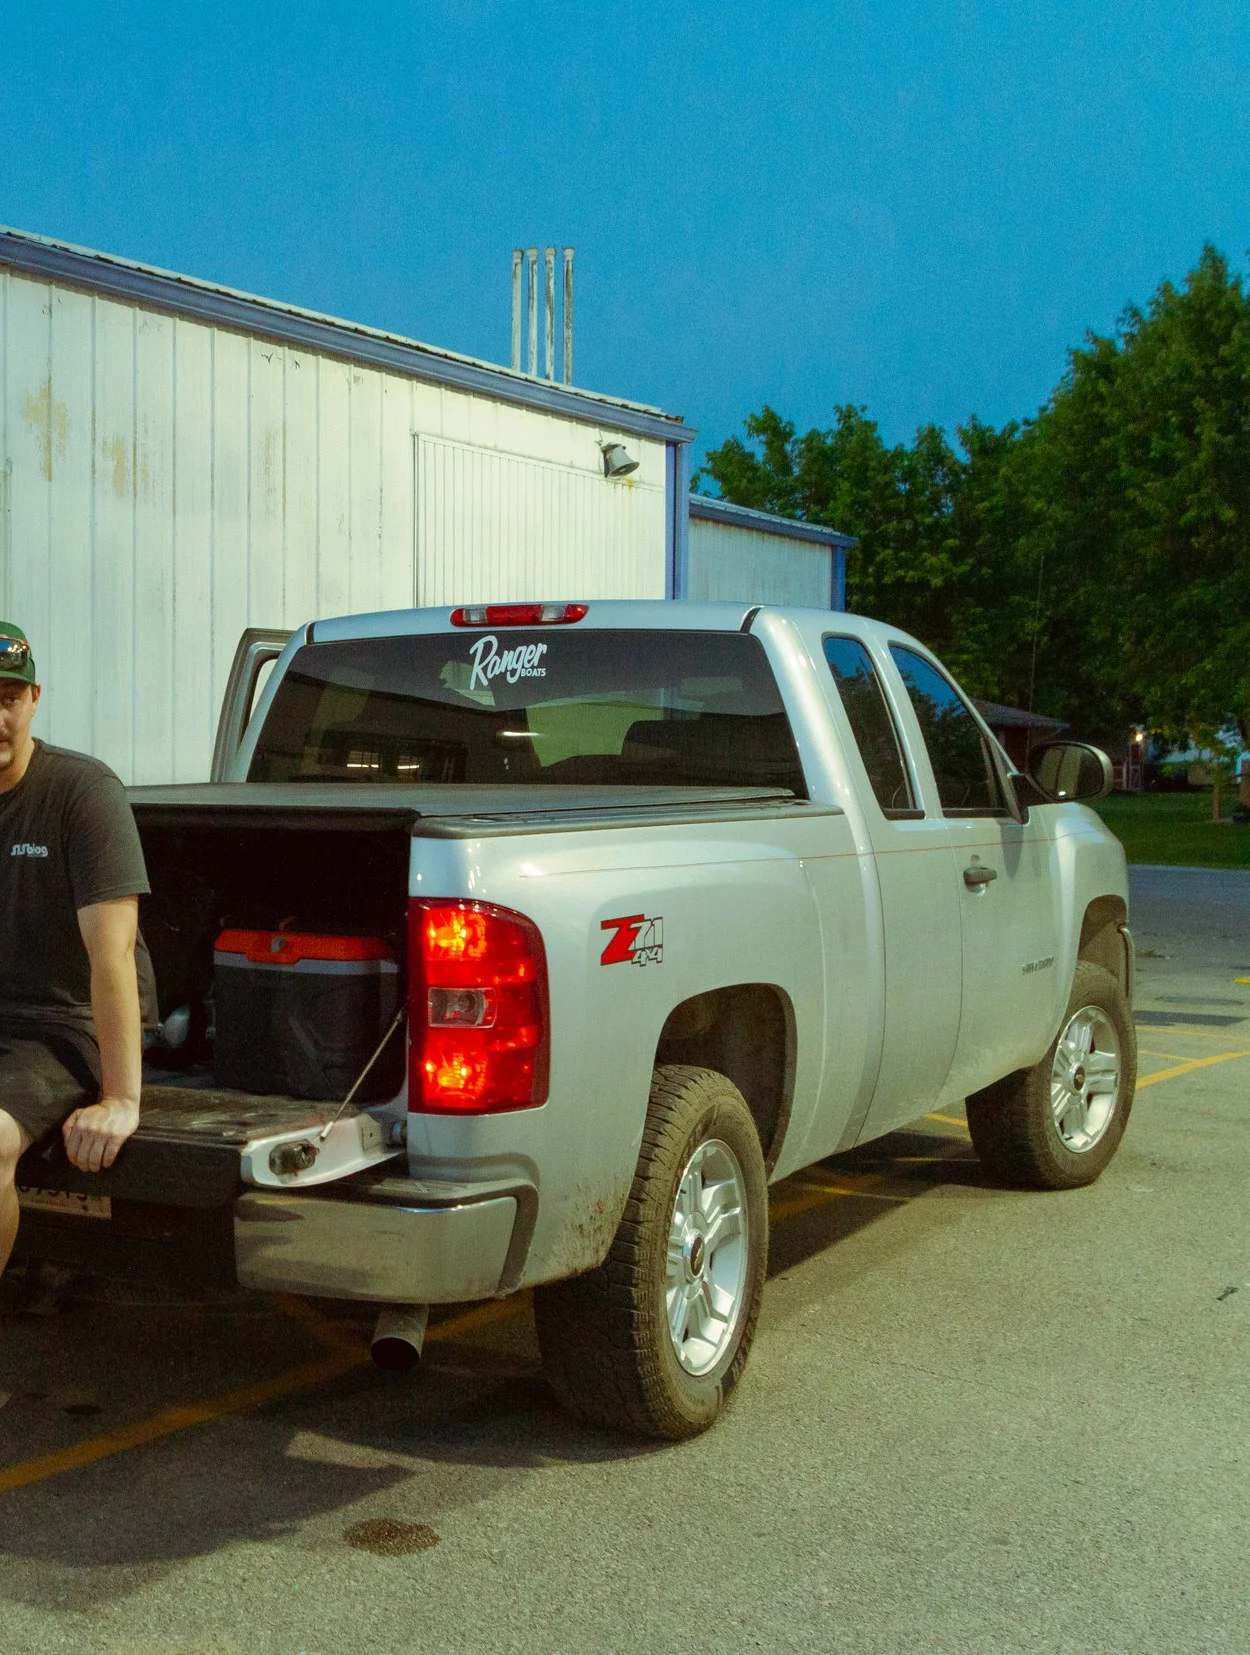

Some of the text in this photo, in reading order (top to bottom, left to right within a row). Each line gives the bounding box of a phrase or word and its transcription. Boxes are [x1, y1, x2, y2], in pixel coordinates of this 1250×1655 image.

[469, 635, 547, 690] Ranger
[521, 668, 546, 677] BOATS
[600, 914, 663, 966] Z71
